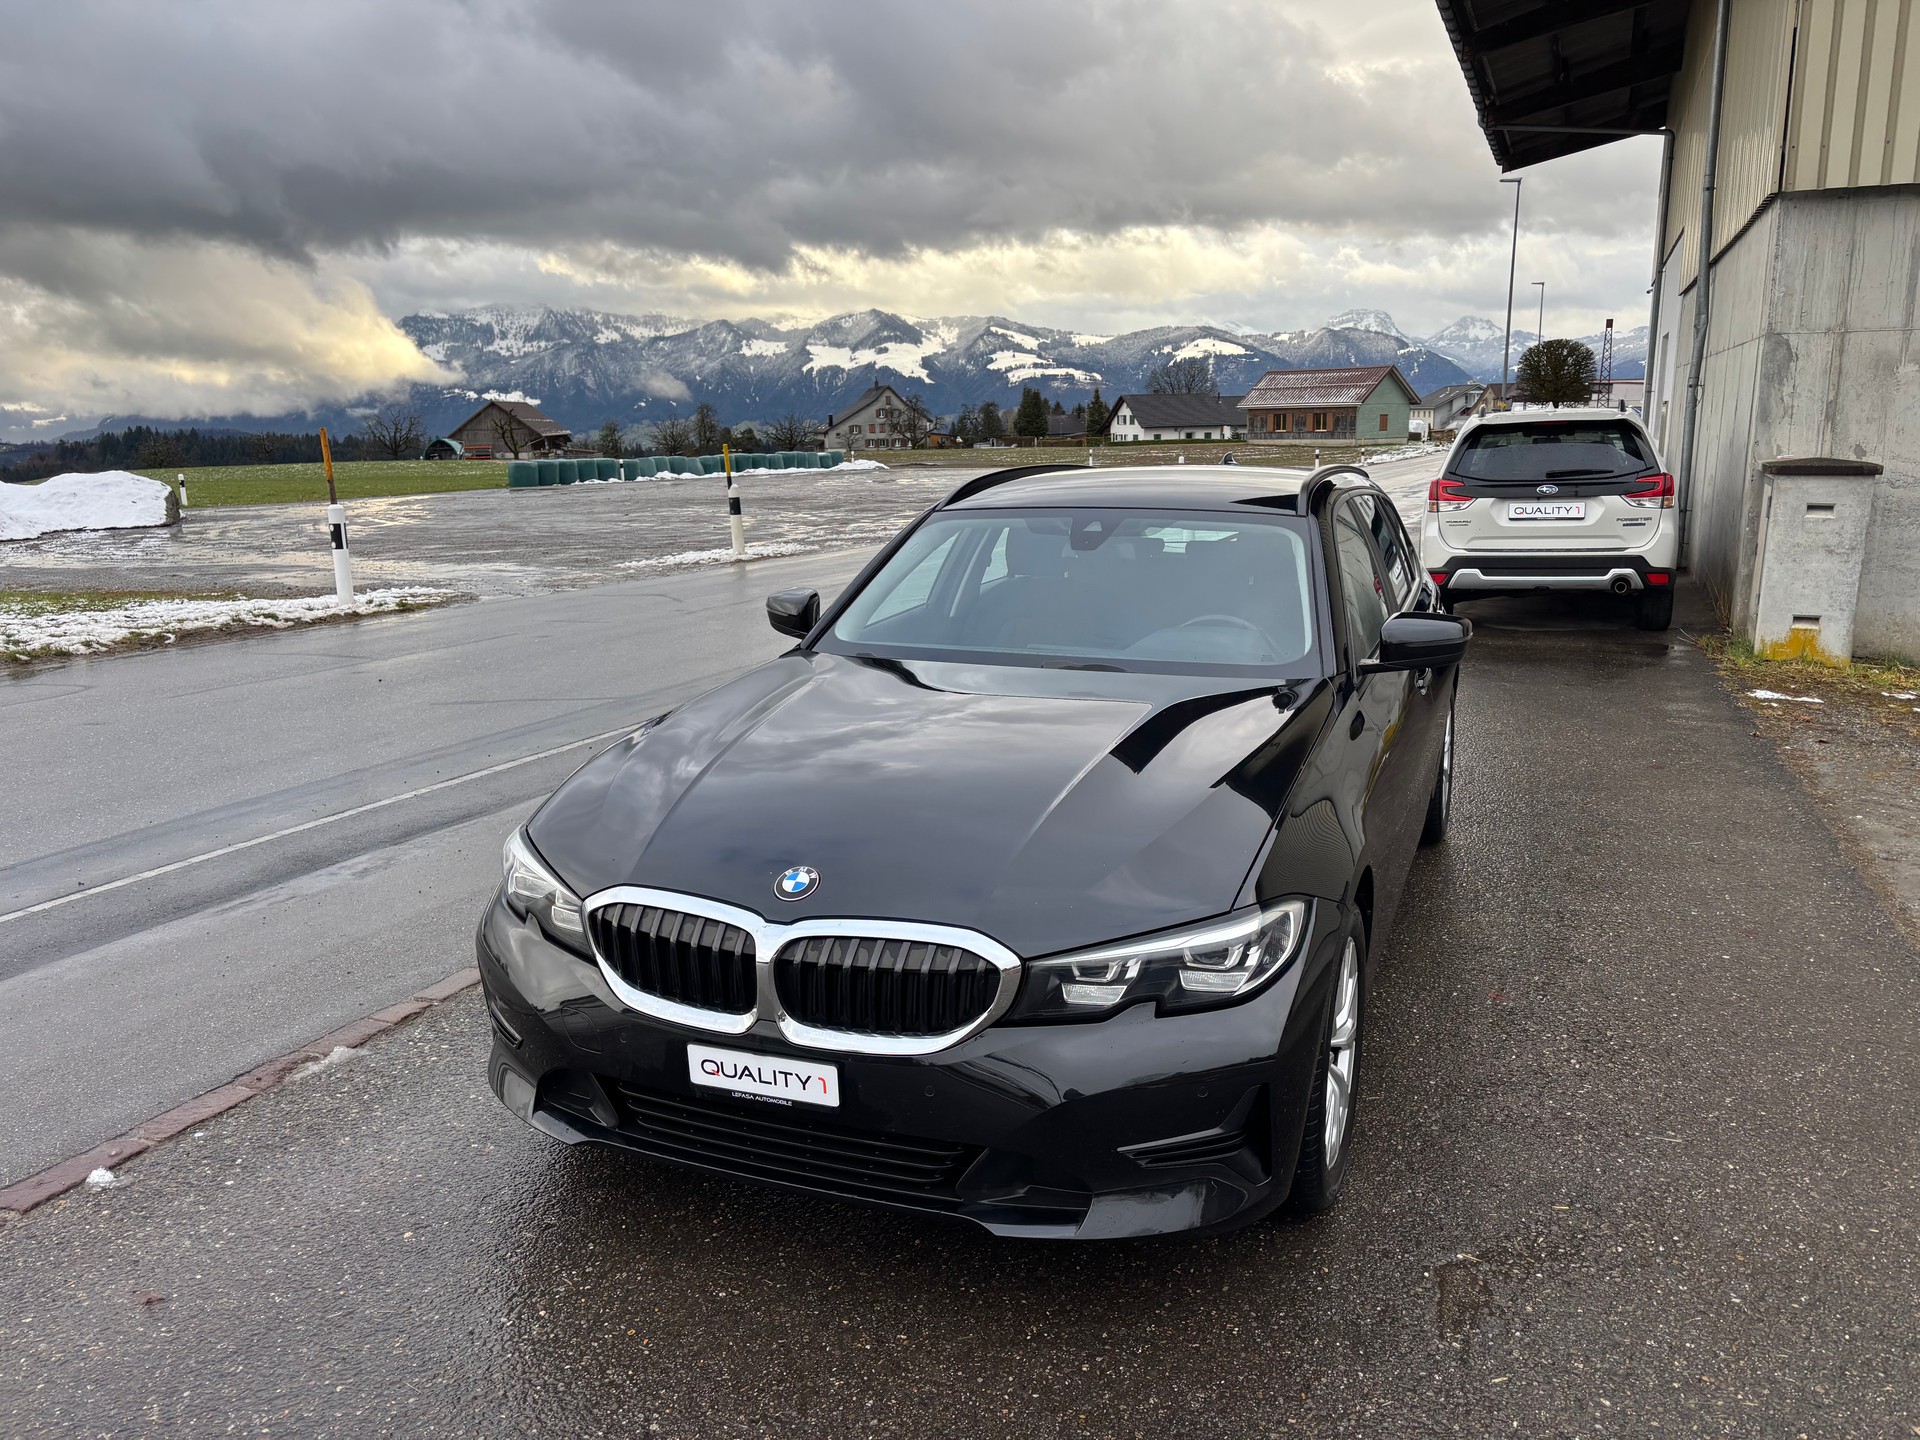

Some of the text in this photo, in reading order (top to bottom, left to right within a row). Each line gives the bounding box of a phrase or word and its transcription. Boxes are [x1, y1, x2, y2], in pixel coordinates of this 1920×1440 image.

[1514, 506, 1580, 515] QUALITY 1
[701, 1059, 827, 1094] QUALITY 1
[731, 1091, 793, 1107] LEFASA AUTOMOBILE
